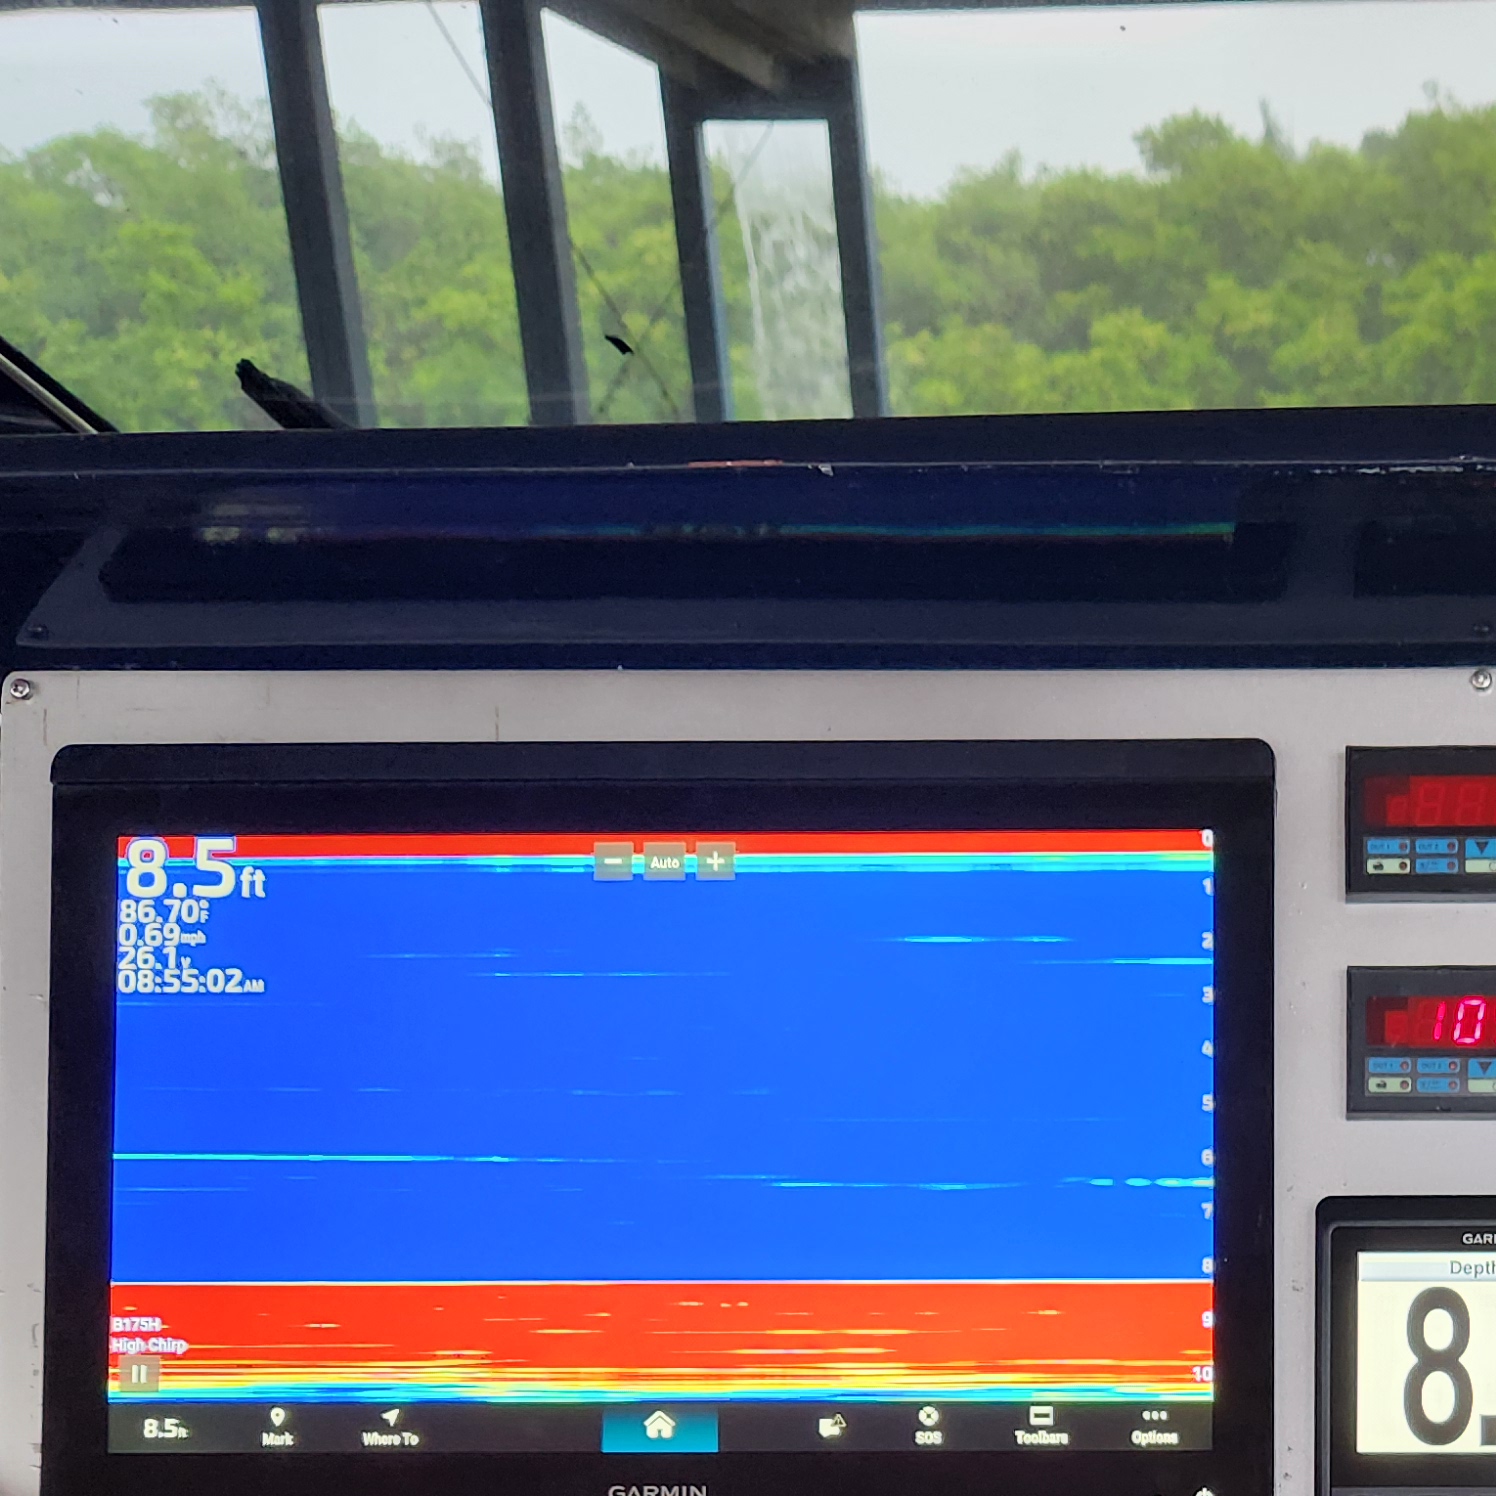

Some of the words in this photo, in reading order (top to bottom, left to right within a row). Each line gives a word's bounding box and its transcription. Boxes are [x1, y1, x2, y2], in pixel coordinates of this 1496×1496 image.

[1202, 829, 1214, 847] 0
[650, 856, 680, 869] Auto
[1202, 878, 1214, 896] 1
[1202, 932, 1214, 950] 2
[1202, 986, 1214, 1004] 3
[1202, 1040, 1214, 1058] 4
[1202, 1094, 1214, 1112] 5
[1201, 1148, 1213, 1166] 6
[1202, 1203, 1213, 1220] 7
[1202, 1257, 1213, 1274] 8
[112, 1317, 162, 1332] B175H
[1202, 1311, 1213, 1328] 9
[112, 1337, 145, 1354] High
[149, 1337, 188, 1354] Chirp
[1192, 1366, 1213, 1382] 10
[261, 1432, 294, 1447] Mark
[362, 1432, 401, 1447] Where
[402, 1432, 419, 1447] To
[914, 1431, 943, 1445] SOS
[1014, 1430, 1069, 1445] Toolbars
[1131, 1431, 1179, 1447] Options
